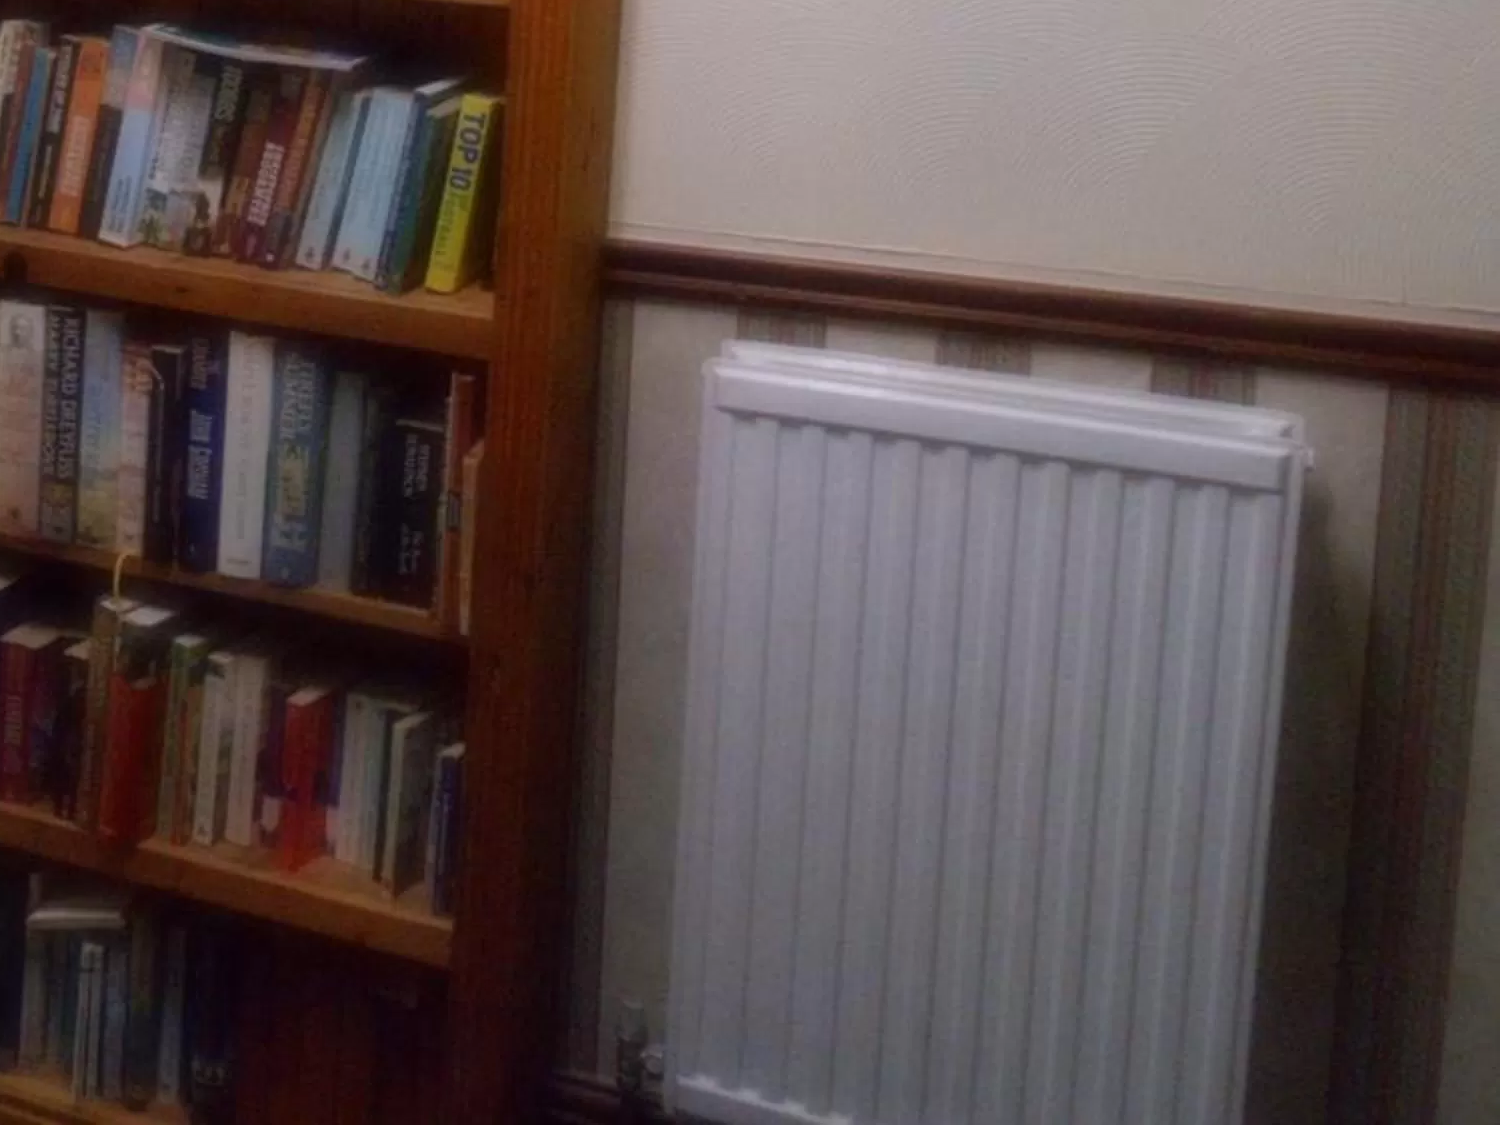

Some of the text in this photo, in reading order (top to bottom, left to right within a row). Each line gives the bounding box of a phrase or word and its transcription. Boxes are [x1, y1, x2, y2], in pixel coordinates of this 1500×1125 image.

[450, 114, 486, 191] TOP 10
[60, 317, 80, 395] RICHARD
